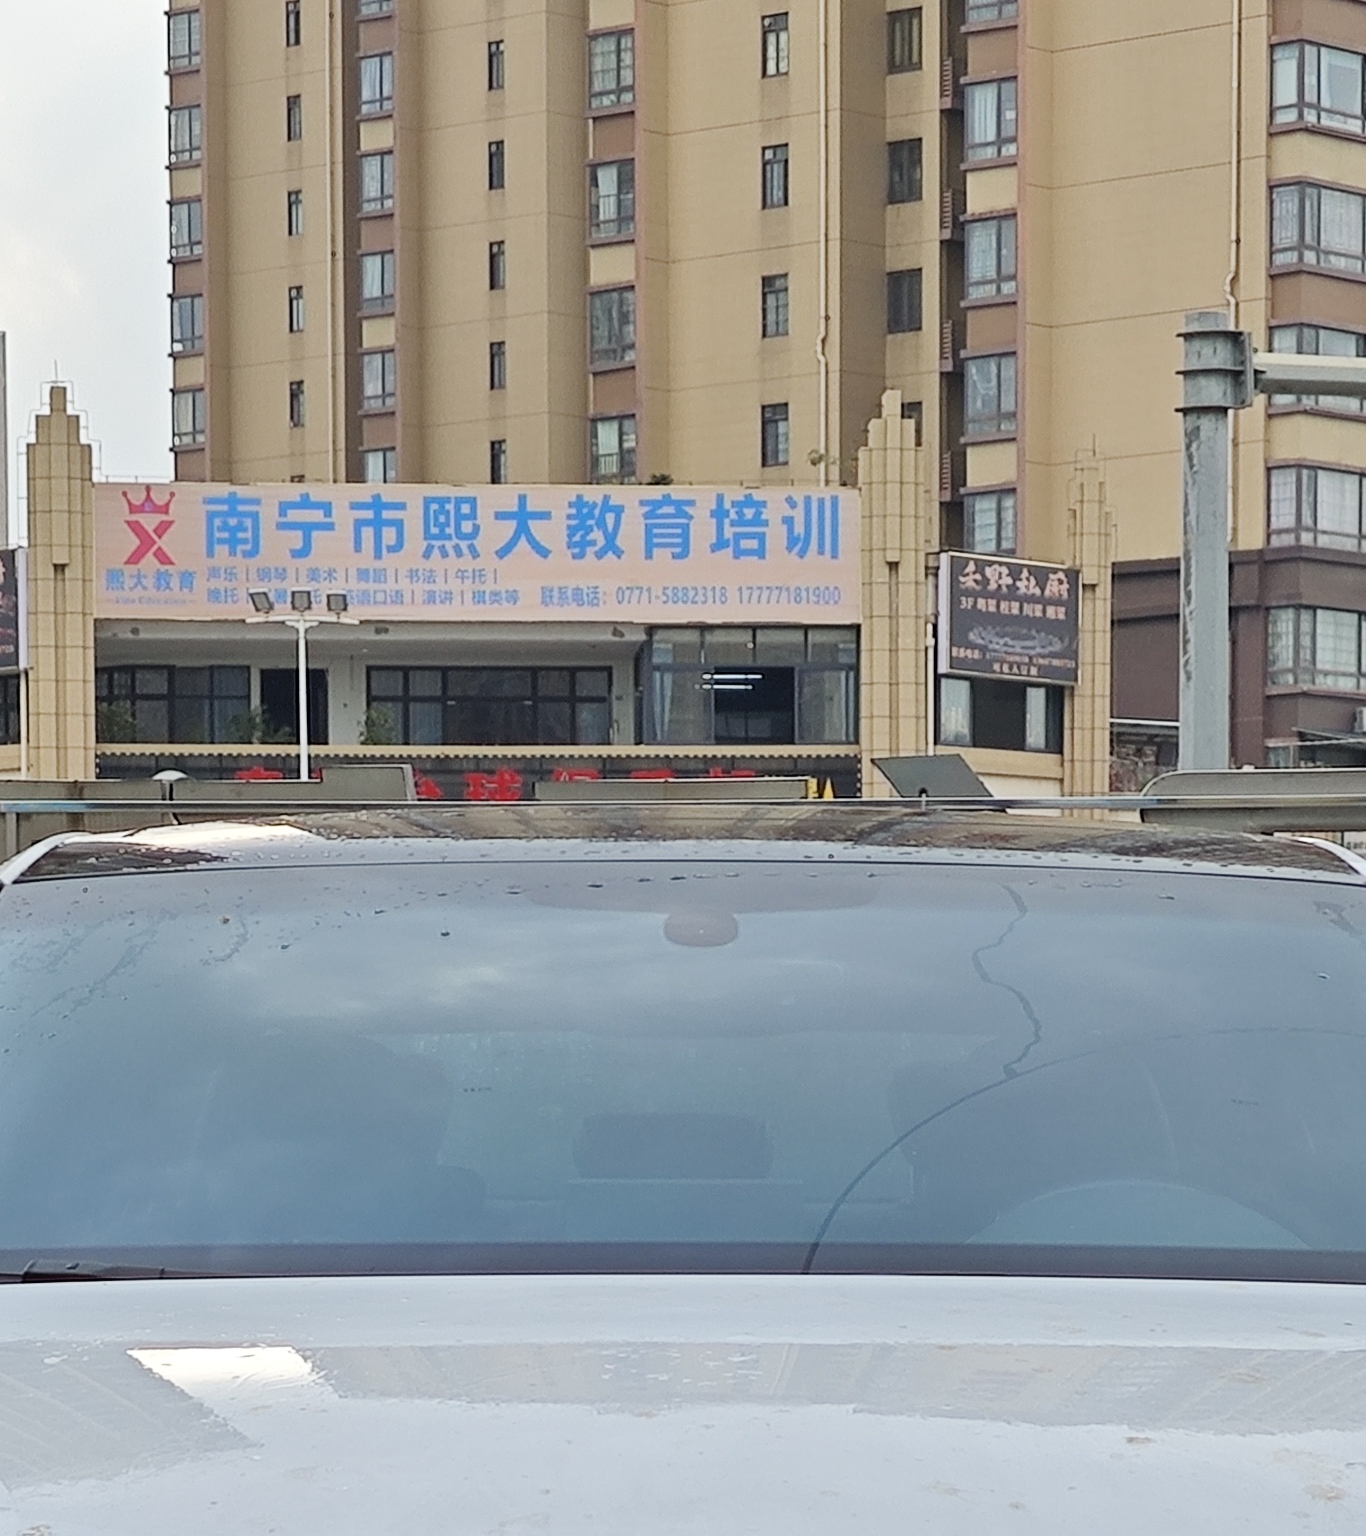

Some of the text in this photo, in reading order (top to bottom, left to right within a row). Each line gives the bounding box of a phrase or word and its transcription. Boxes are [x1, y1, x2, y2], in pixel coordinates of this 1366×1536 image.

[203, 491, 840, 560] 南宁市熙大教育培训
[306, 567, 337, 583] 美术
[405, 568, 437, 584] 书法
[455, 568, 487, 584] 午托
[615, 586, 728, 605] 0771-5882318
